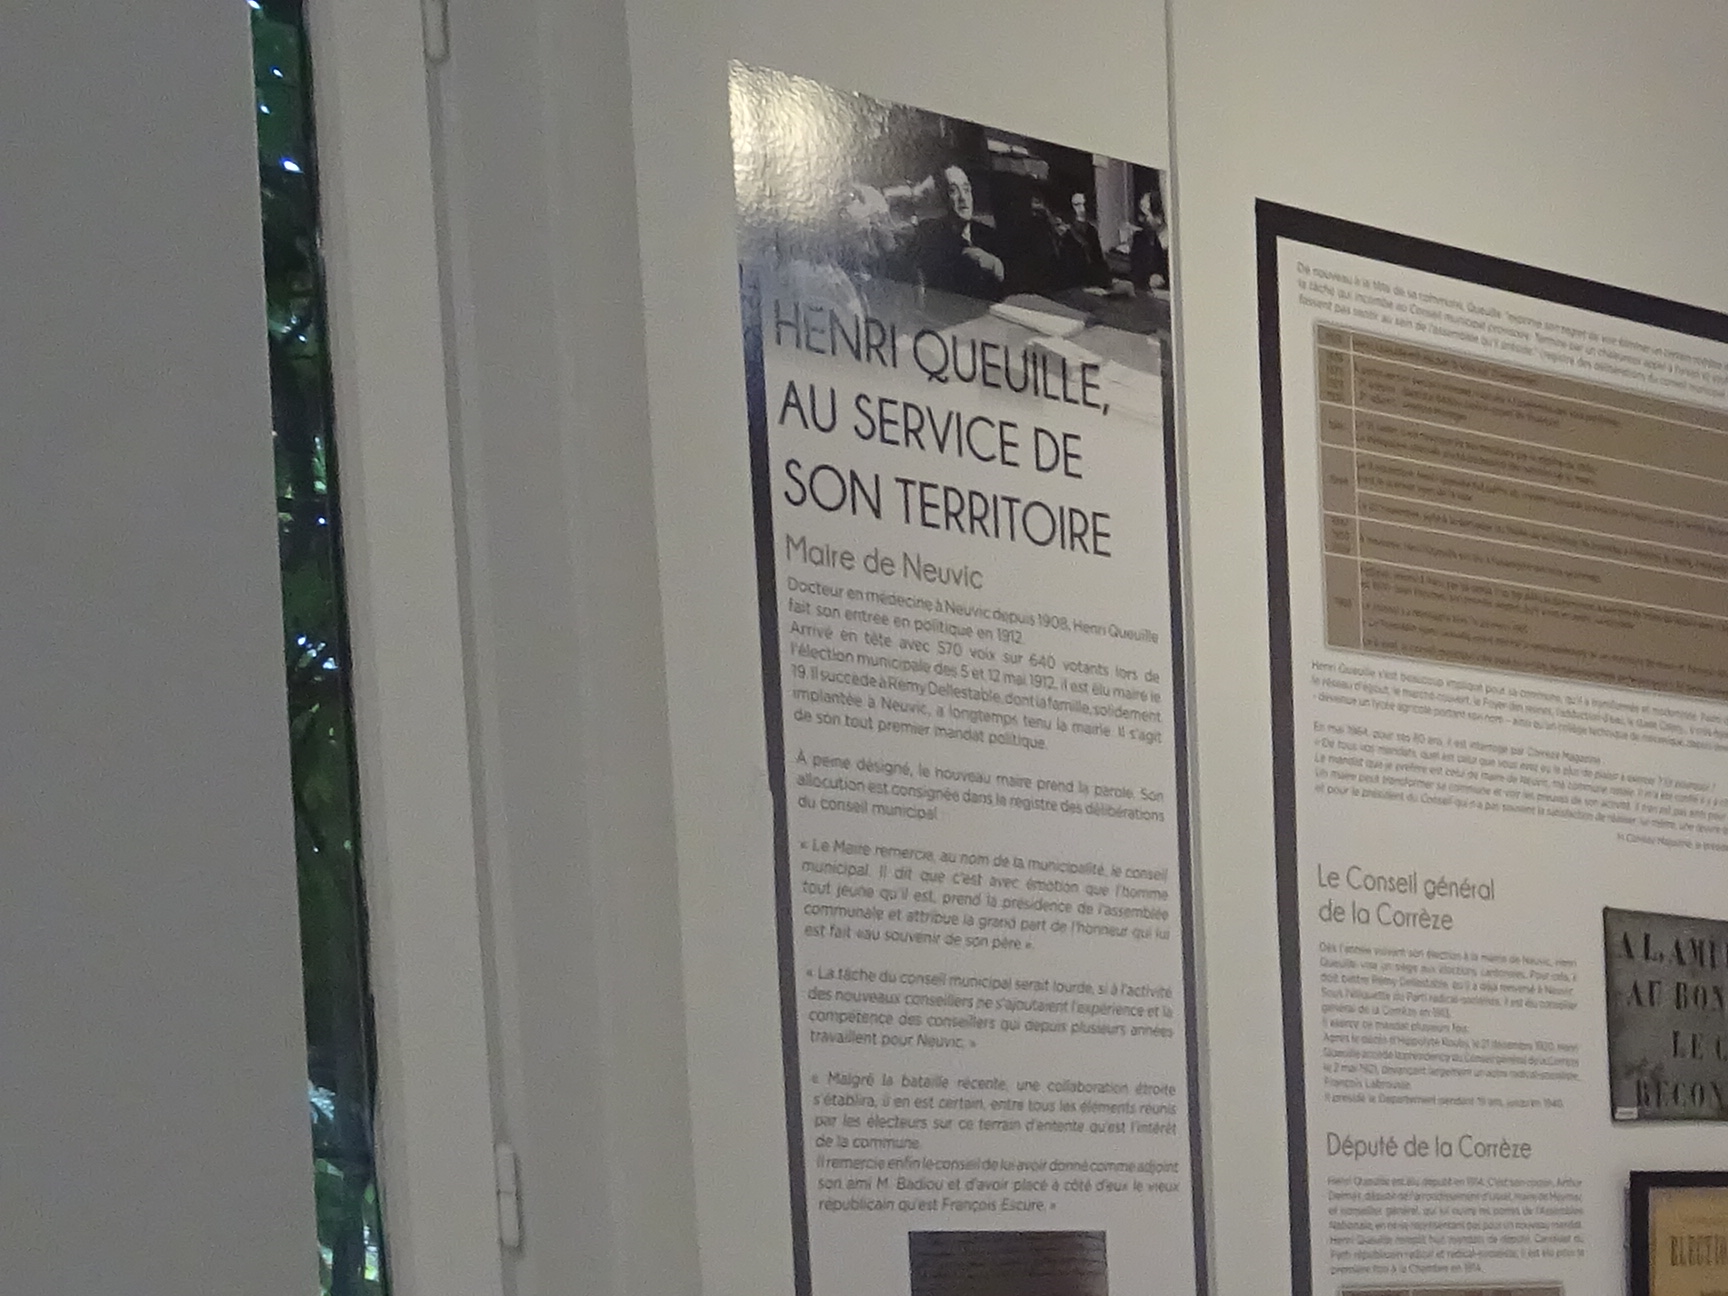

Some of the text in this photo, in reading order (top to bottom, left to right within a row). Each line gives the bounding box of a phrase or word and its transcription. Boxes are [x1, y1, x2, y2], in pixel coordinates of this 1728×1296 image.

[775, 299, 1109, 415] HENRI QUEUILLE,
[778, 380, 1082, 479] AU SERVICE DE
[784, 459, 1111, 558] SON TERRITOIRE
[785, 533, 984, 590] Maire de Neuvic
[1317, 863, 1495, 900] Le Conseil général
[1319, 899, 1453, 930] de la Corrèze
[1326, 1132, 1532, 1160] Député de la Corrèze
